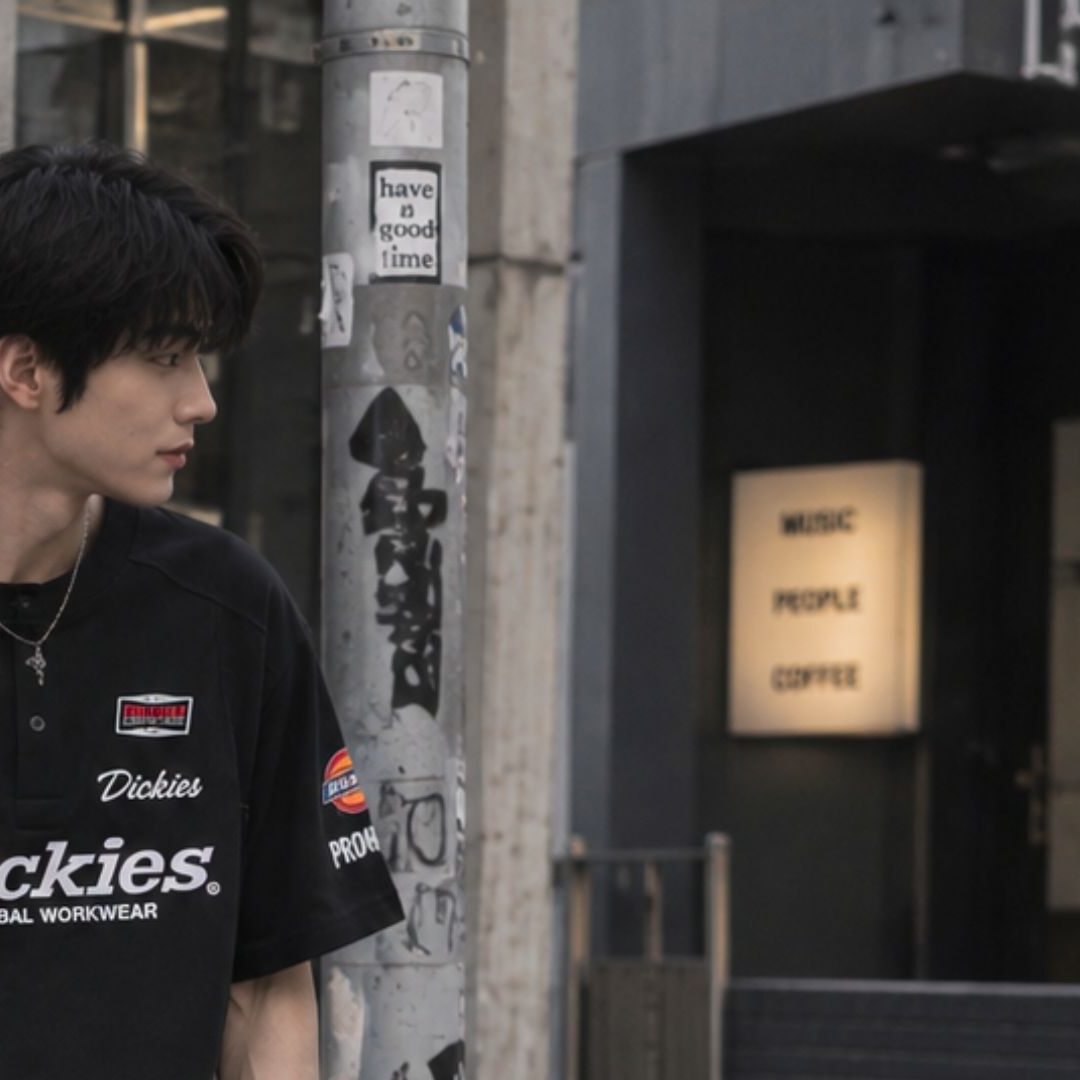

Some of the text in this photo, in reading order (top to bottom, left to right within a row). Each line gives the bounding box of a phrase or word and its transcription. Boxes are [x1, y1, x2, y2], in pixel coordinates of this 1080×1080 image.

[380, 177, 434, 199] have
[379, 220, 435, 242] good
[780, 506, 856, 536] MUSIC
[772, 586, 860, 615] PEOPLE
[772, 663, 857, 690] COFFEE
[97, 769, 203, 802] Dickies
[39, 902, 158, 923] WORKWEAR
